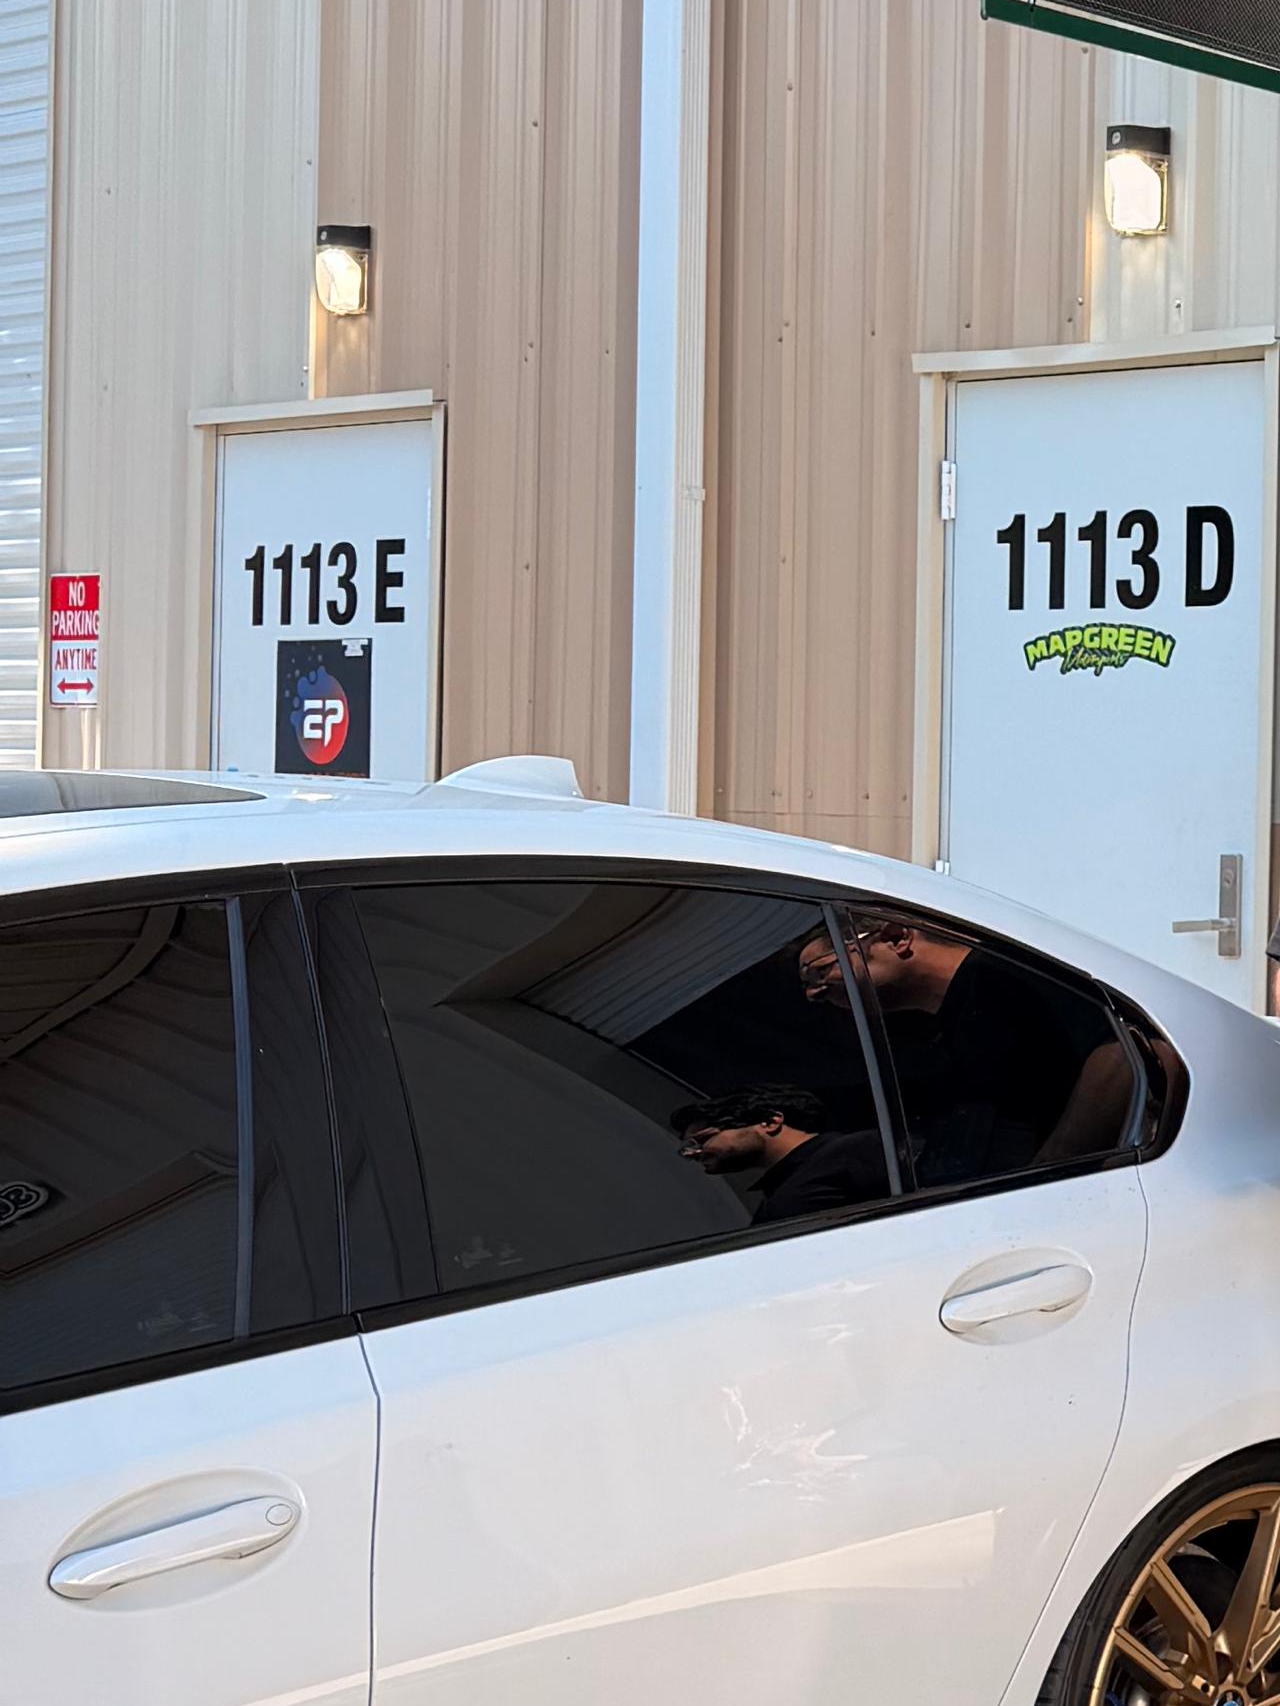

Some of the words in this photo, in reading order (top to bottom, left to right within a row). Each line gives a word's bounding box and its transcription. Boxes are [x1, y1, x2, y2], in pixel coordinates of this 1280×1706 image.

[996, 508, 1160, 611] 1113
[1184, 505, 1235, 608] D
[68, 580, 86, 607] NO
[245, 541, 358, 627] 1113
[374, 538, 406, 623] E
[52, 610, 100, 636] PARKING
[55, 648, 97, 670] ANYTIME
[1024, 624, 1176, 670] MAPGREEN
[303, 699, 345, 747] EP
